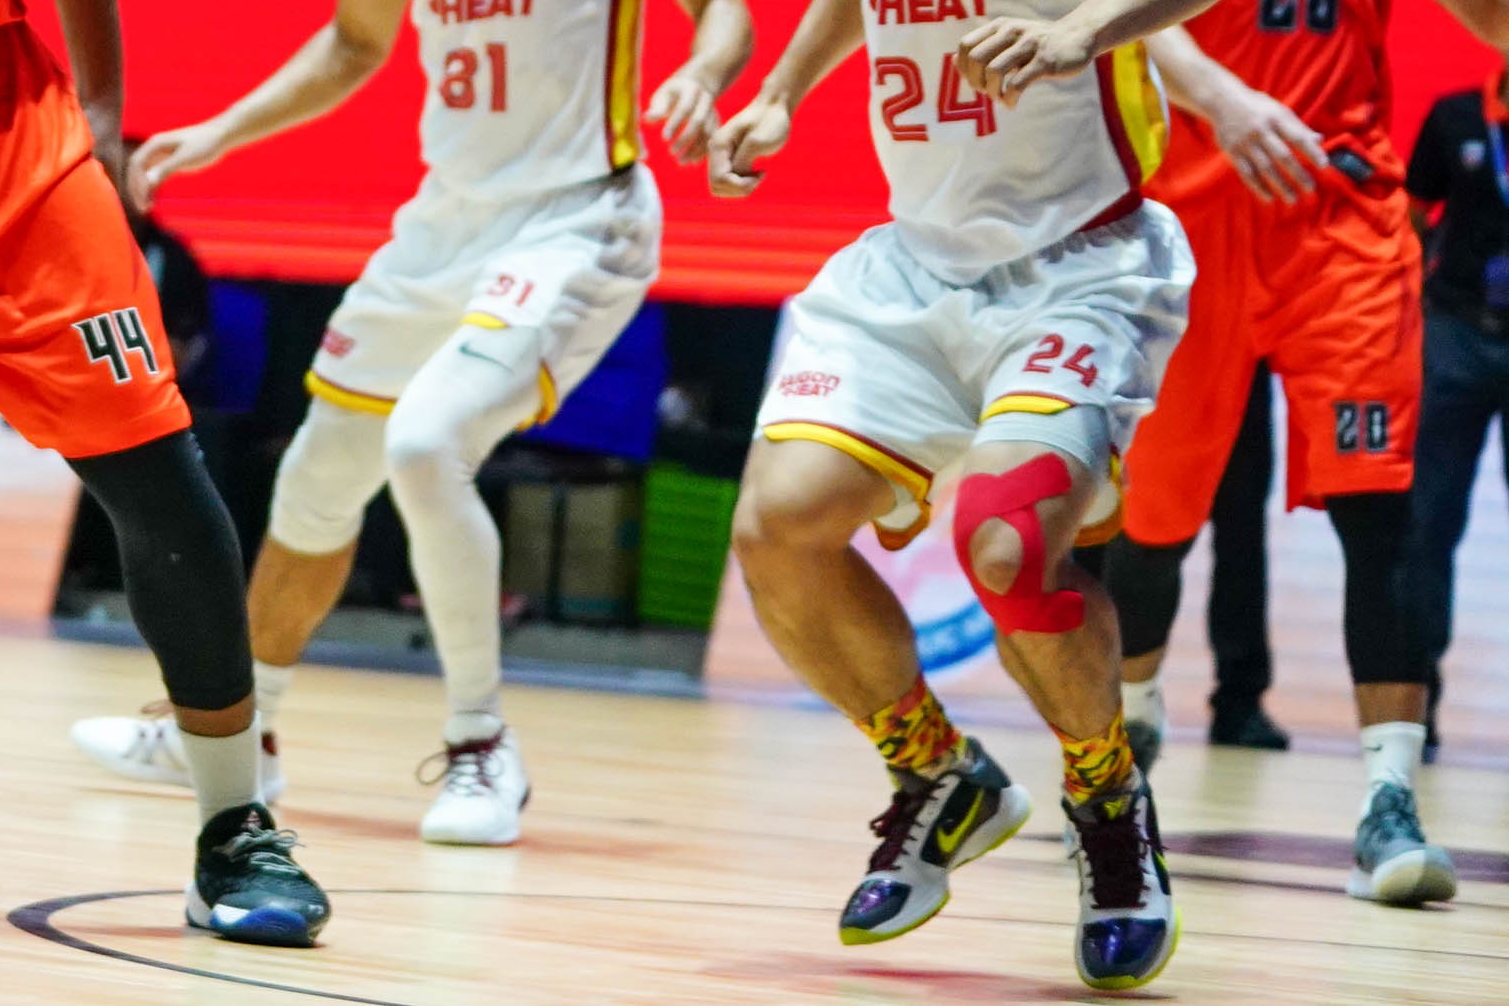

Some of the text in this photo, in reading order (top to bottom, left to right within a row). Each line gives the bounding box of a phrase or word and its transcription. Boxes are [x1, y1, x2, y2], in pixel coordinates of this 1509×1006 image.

[875, 52, 997, 142] 24
[71, 306, 159, 384] 44
[1022, 333, 1100, 388] 24
